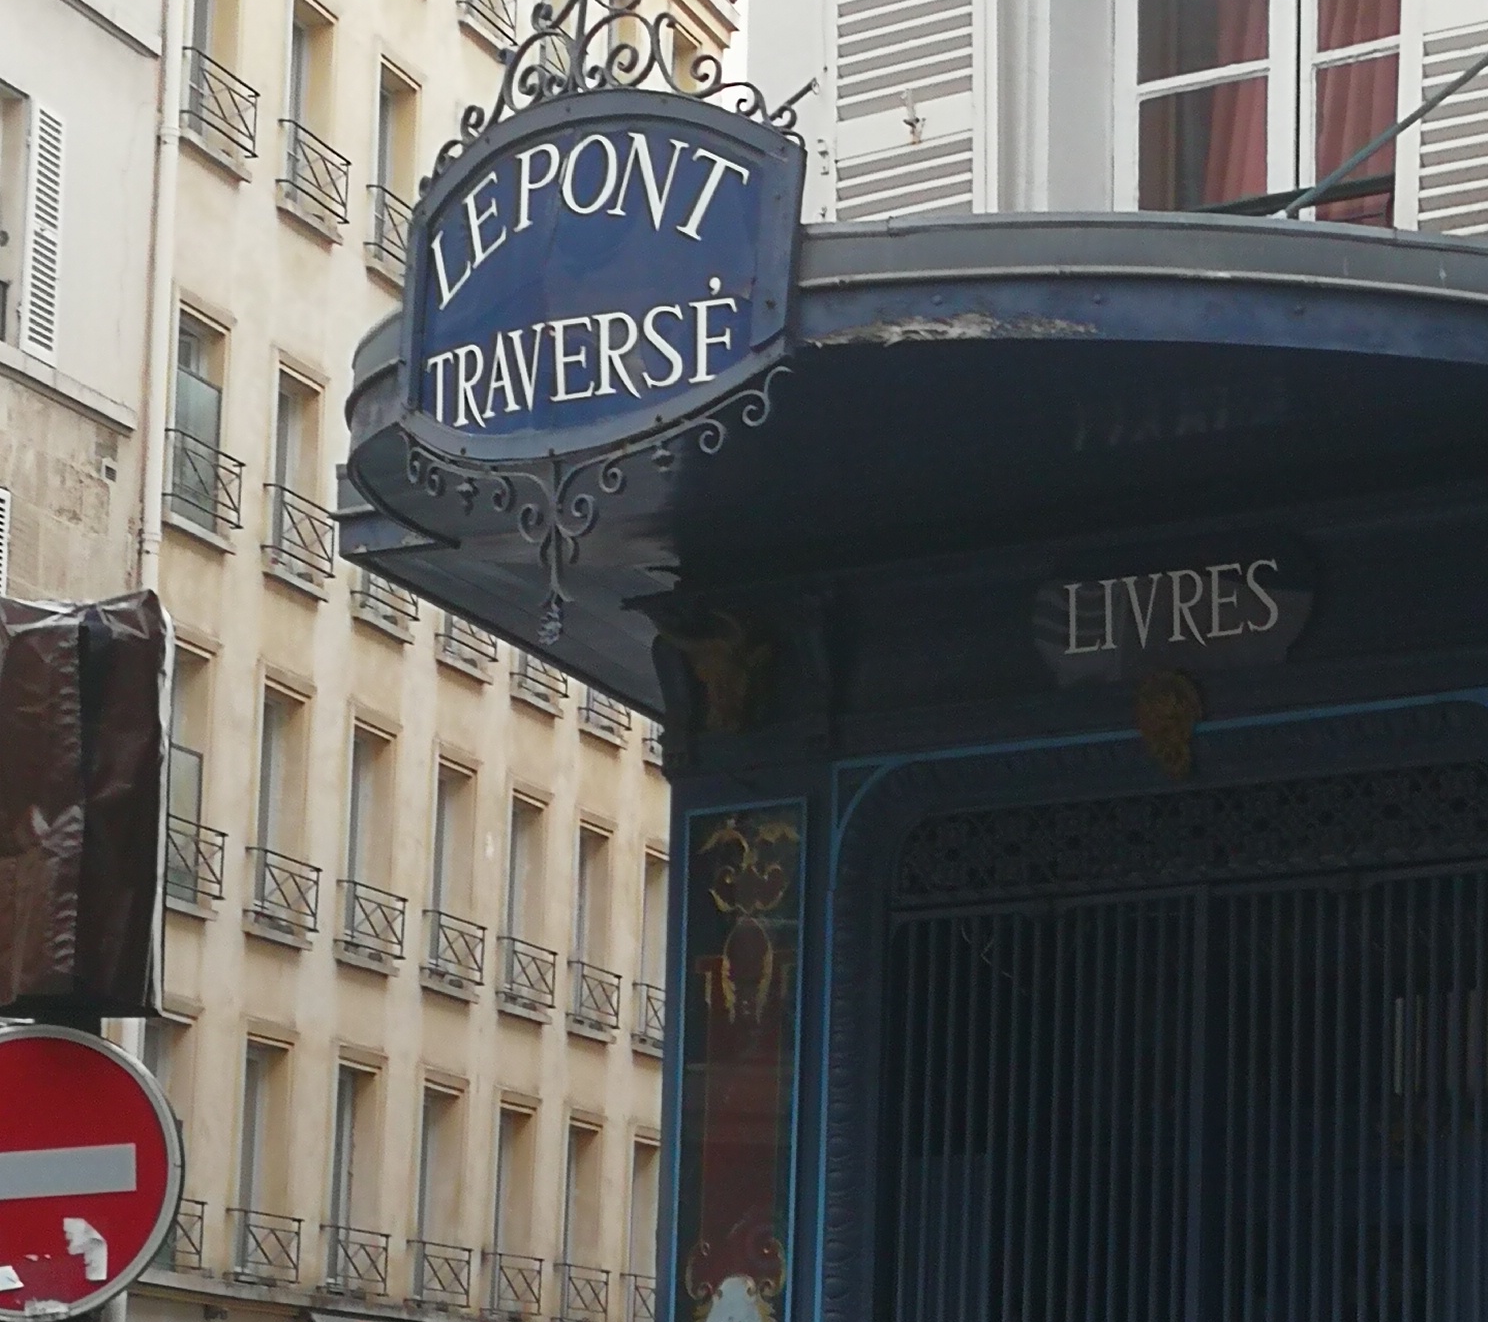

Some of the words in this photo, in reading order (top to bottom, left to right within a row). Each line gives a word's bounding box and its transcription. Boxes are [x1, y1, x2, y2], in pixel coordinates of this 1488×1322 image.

[428, 171, 508, 311] LE
[513, 132, 750, 242] PONT
[426, 276, 738, 429] TRAVERSÉ
[1063, 558, 1280, 656] LIVRES
